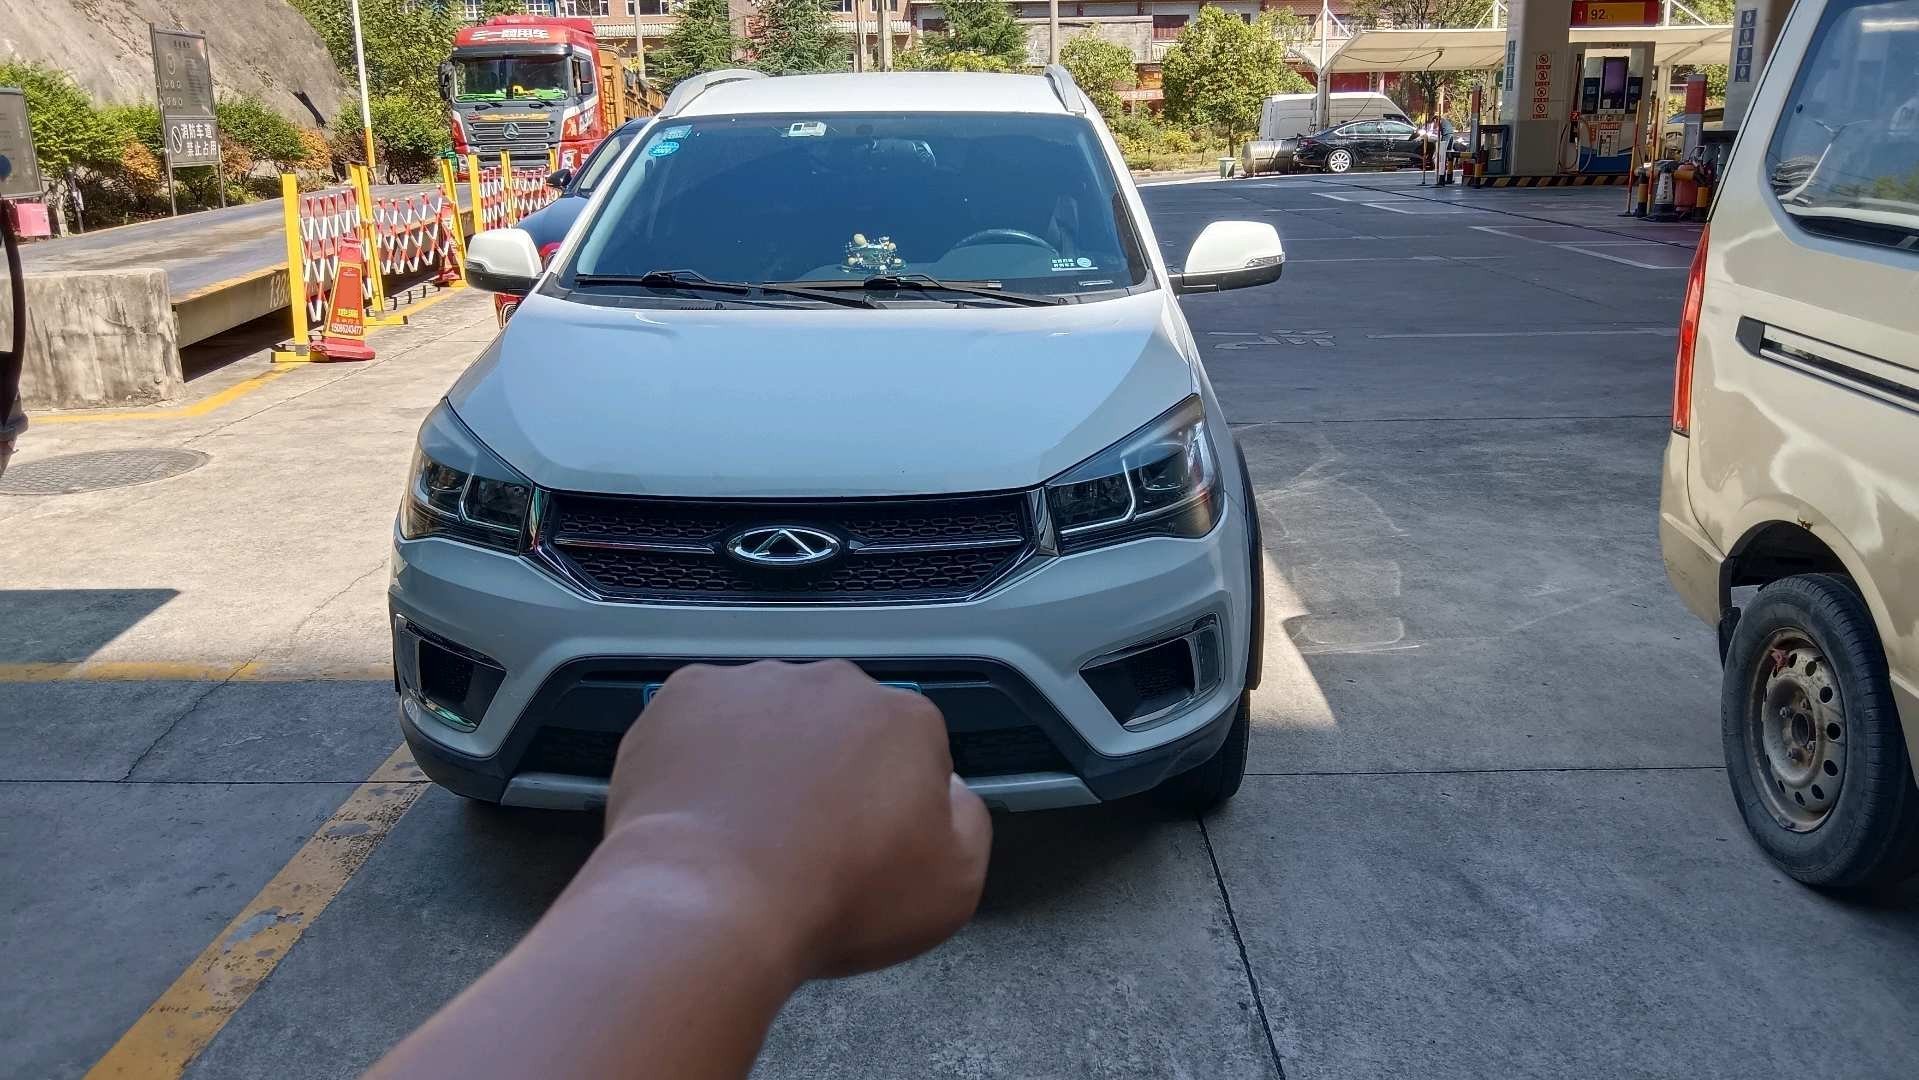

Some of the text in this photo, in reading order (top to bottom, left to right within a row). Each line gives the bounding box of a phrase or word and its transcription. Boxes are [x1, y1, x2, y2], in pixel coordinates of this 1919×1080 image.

[1591, 9, 1607, 20] 92
[181, 123, 213, 139] 消防车道
[186, 141, 217, 156] 禁止占用
